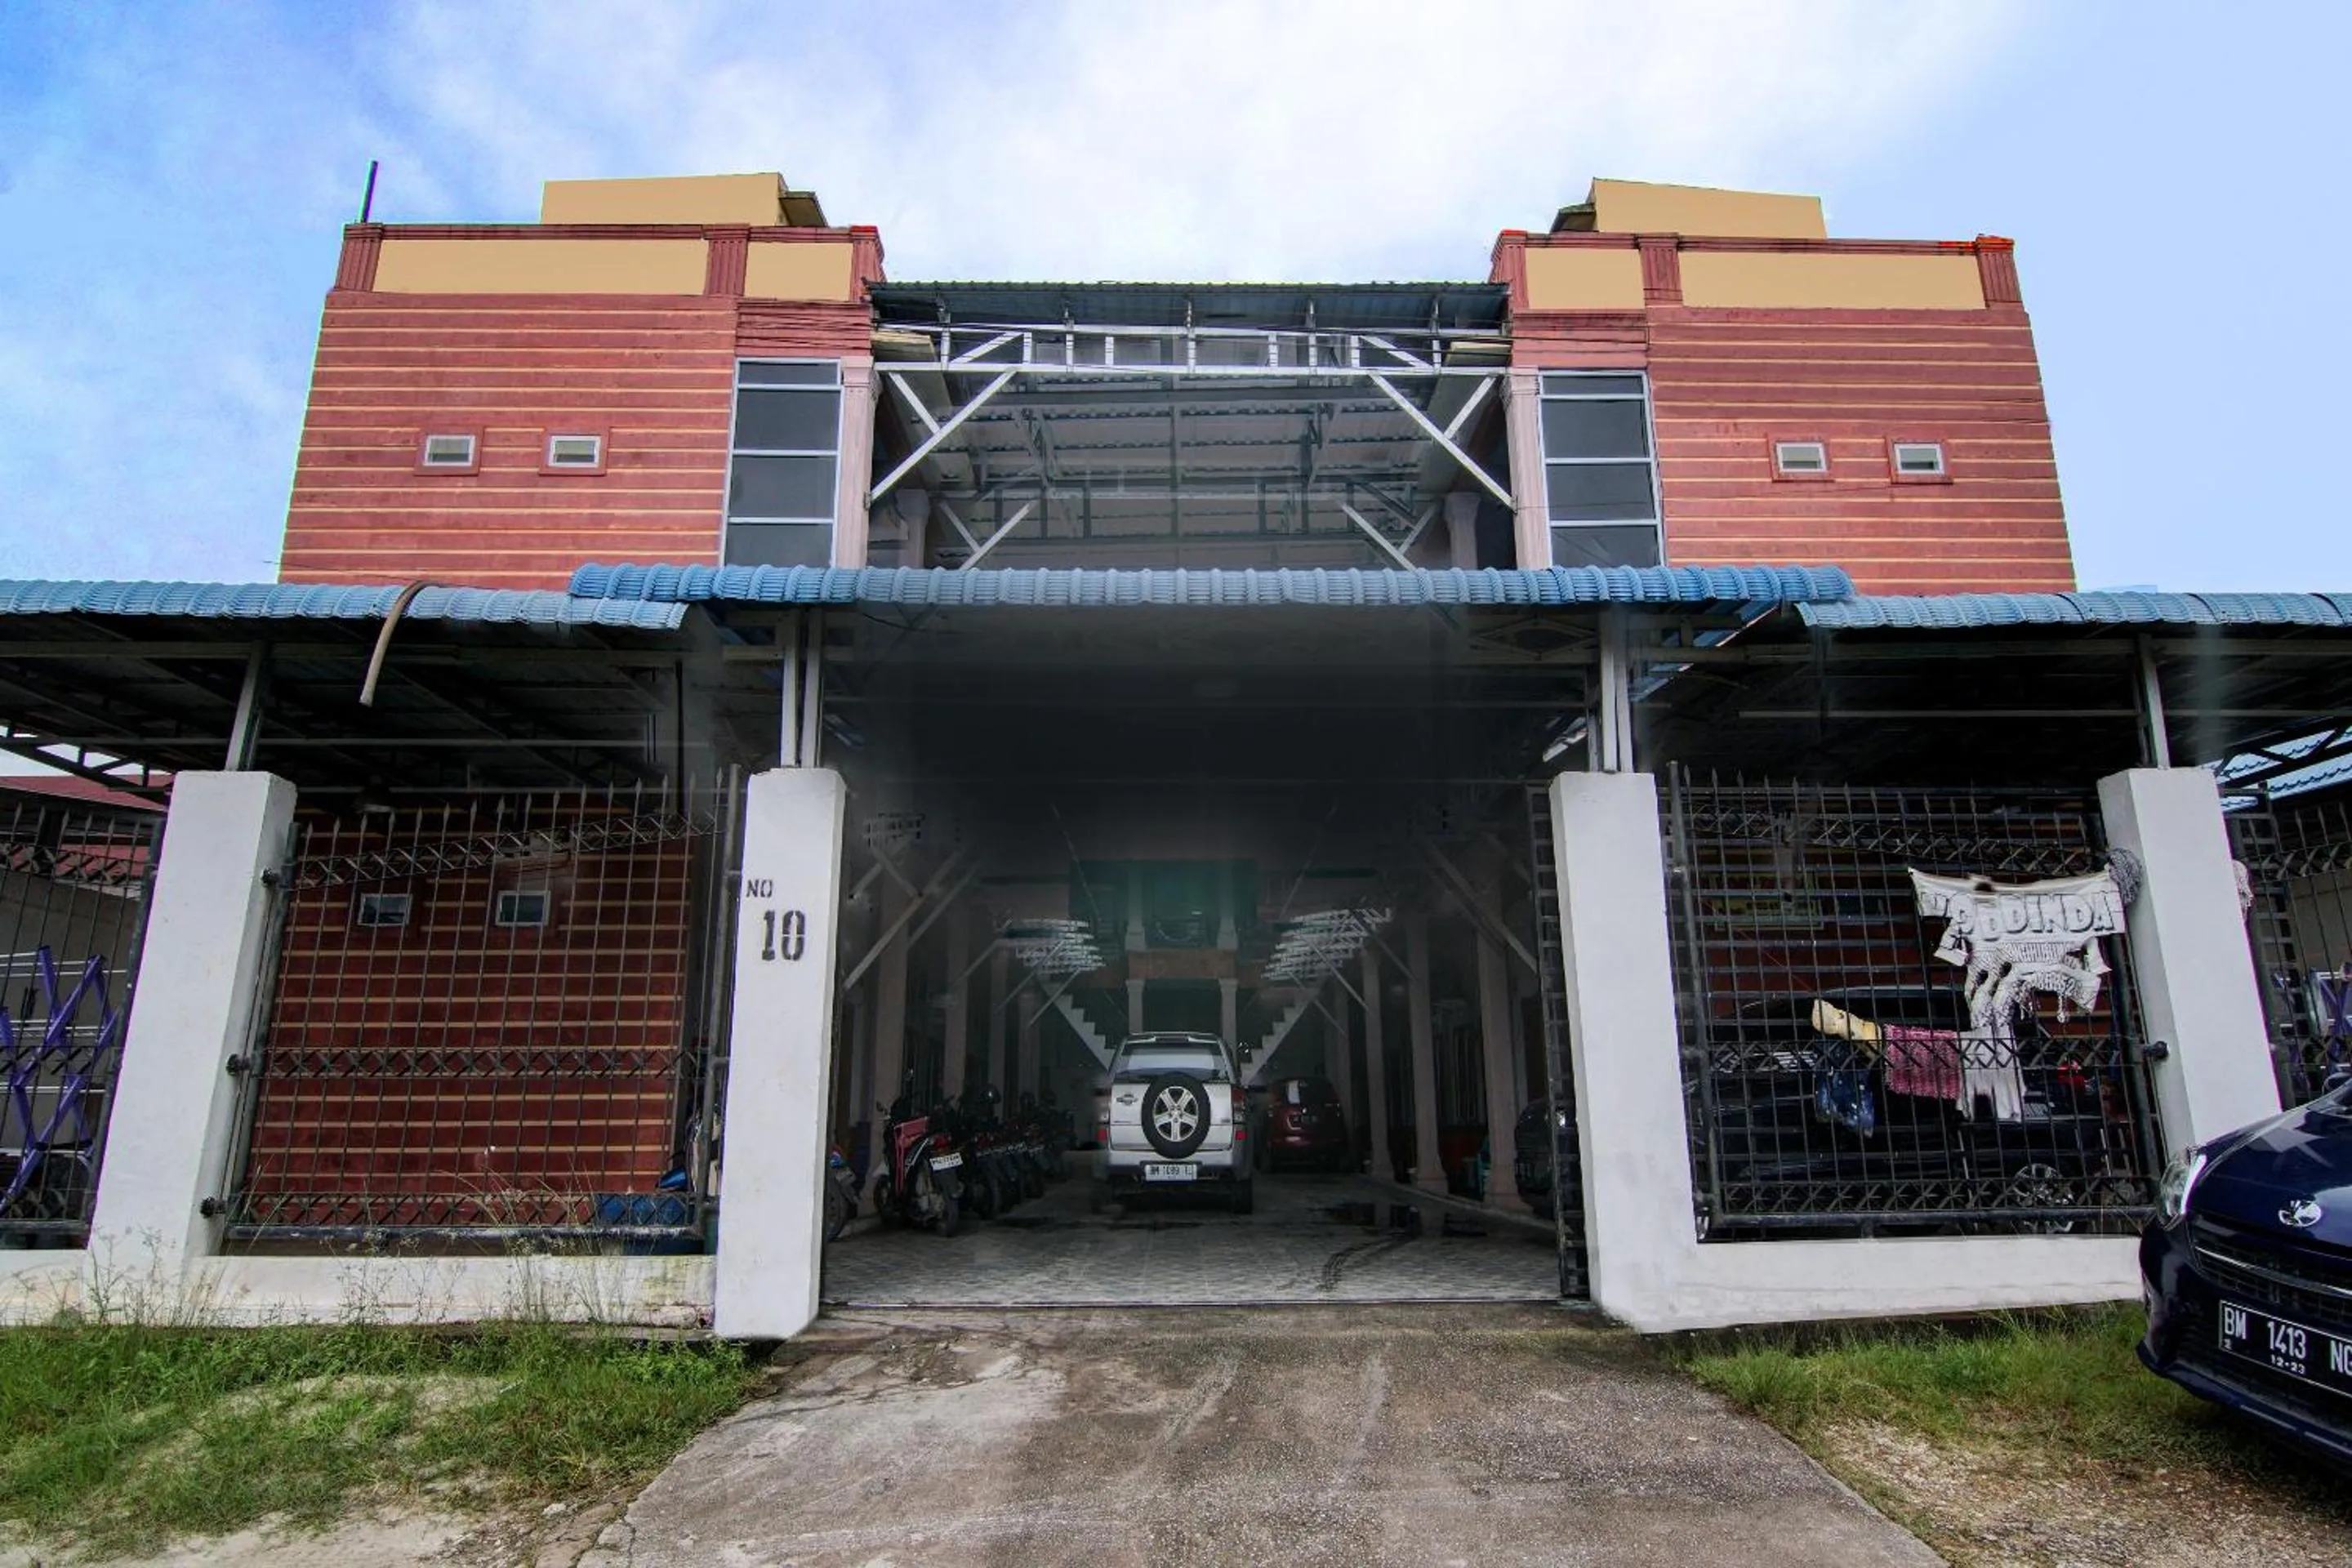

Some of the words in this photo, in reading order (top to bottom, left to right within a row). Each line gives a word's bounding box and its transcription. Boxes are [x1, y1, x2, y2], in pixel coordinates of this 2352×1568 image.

[746, 879, 773, 898] NO
[762, 910, 805, 961] 10
[2225, 1307, 2247, 1340] BM
[2267, 1321, 2306, 1360] 1413
